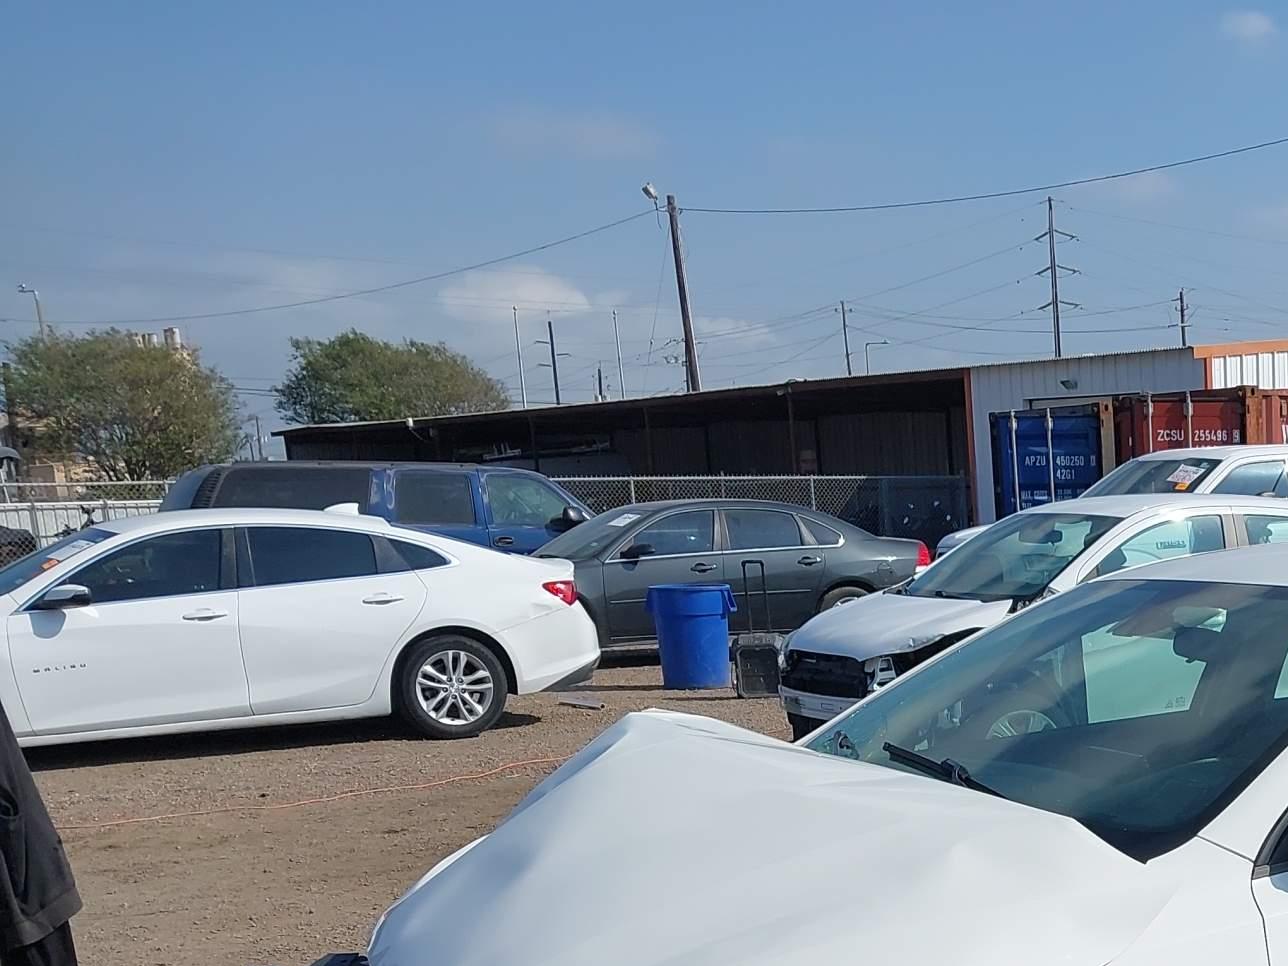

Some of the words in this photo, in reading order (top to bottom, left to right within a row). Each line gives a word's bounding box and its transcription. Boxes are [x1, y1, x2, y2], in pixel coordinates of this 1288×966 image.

[1156, 428, 1185, 441] ZCSU
[1193, 429, 1228, 441] 255496
[1024, 455, 1046, 466] APZU
[1055, 455, 1085, 467] 450250
[1056, 468, 1076, 480] 42G1
[32, 663, 87, 674] MALIBU
